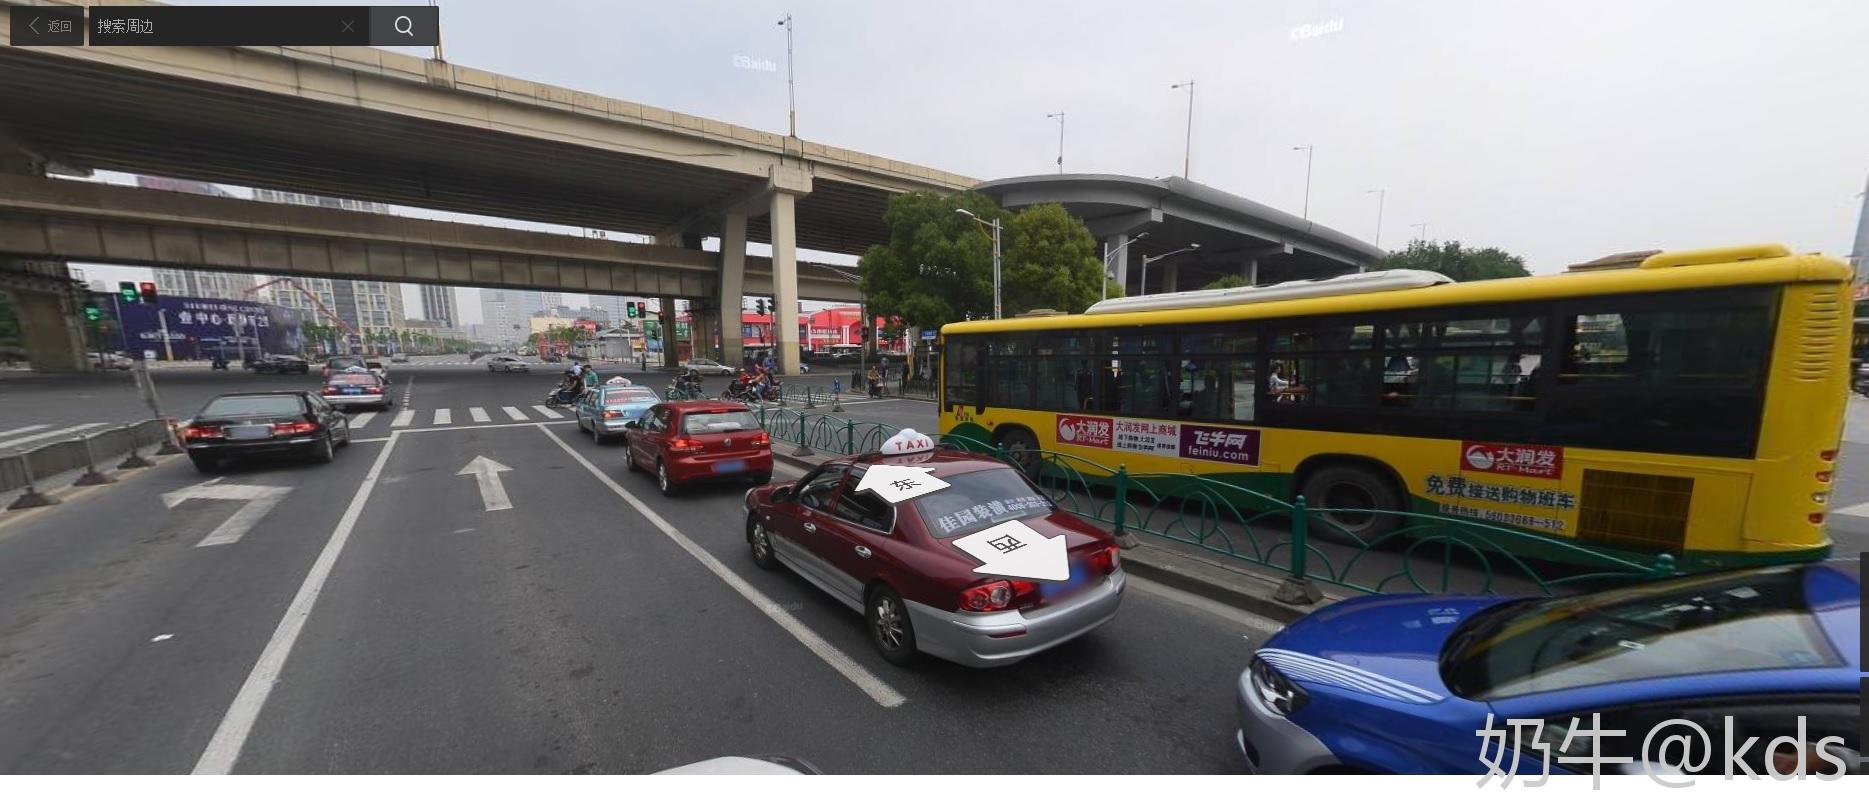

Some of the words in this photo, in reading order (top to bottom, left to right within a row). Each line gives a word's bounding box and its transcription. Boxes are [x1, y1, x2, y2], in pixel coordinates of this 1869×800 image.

[1075, 419, 1110, 438] 大润发
[1115, 421, 1177, 437] 大润发网上商城
[895, 439, 929, 451] TAXI
[1193, 429, 1249, 450] 飞牛网
[1188, 445, 1249, 461] feiniu.com
[1495, 447, 1557, 466] 大润发
[1425, 475, 1575, 509] 免费接送购物班车
